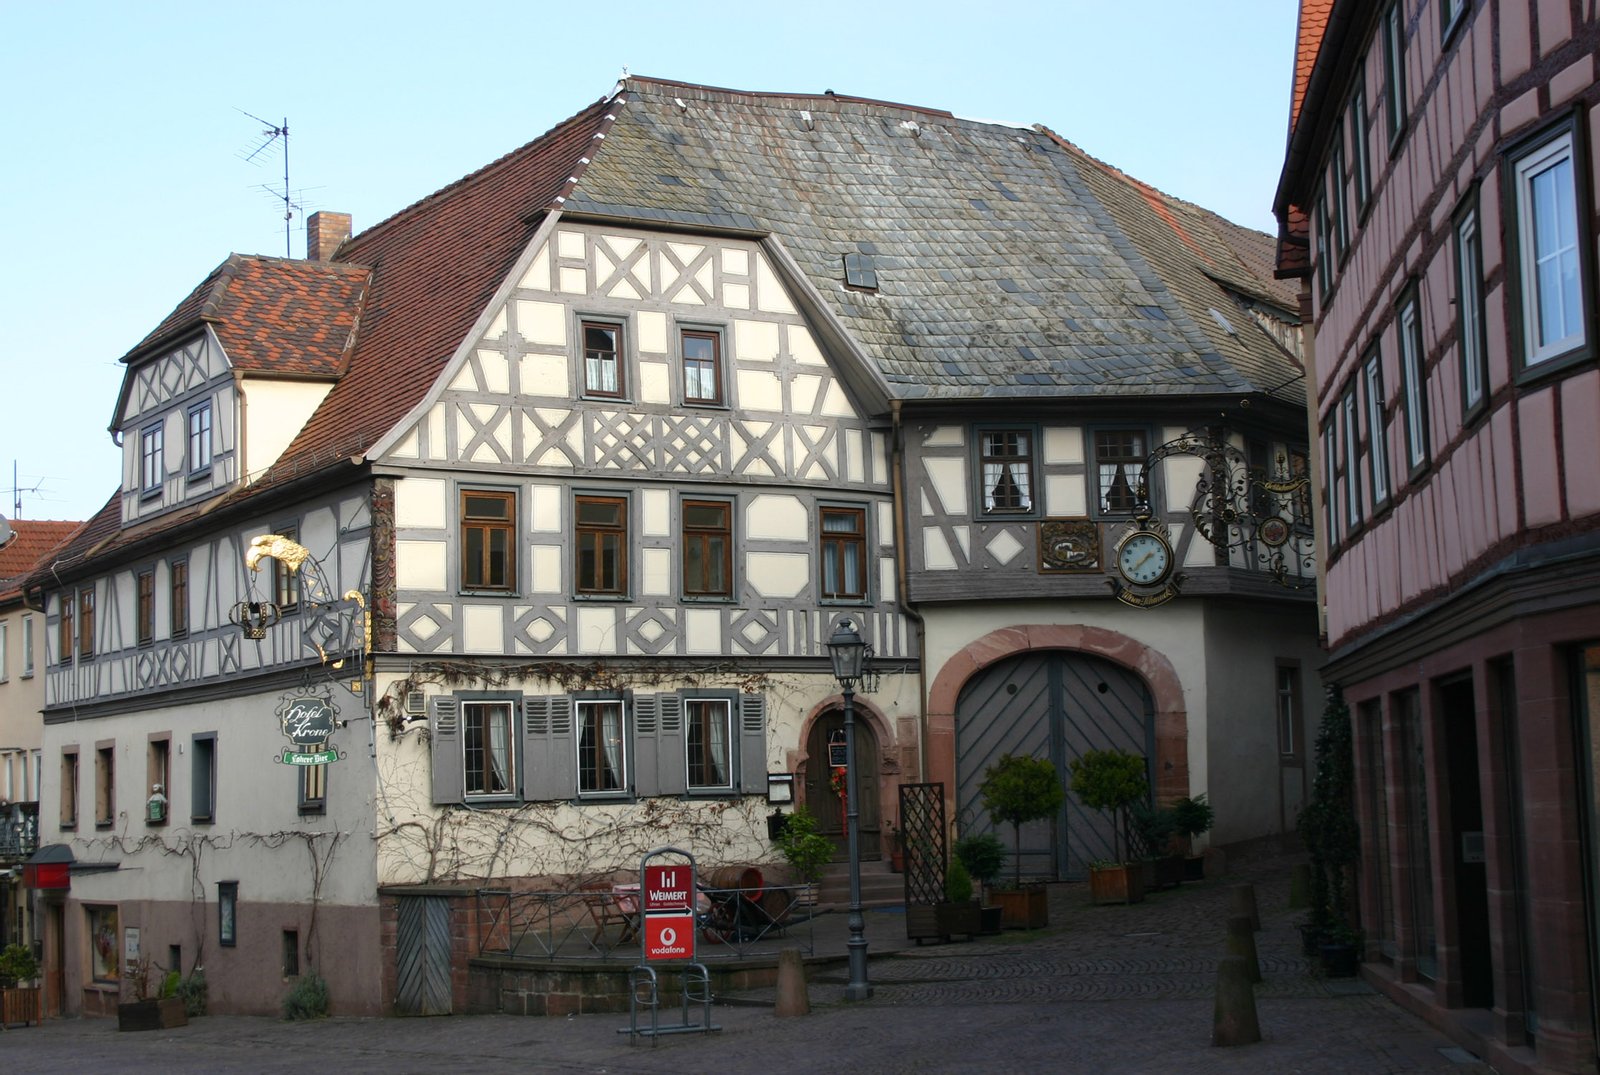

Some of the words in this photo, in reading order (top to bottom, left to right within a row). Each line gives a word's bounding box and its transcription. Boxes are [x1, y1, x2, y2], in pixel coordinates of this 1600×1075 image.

[287, 705, 323, 723] Hotel
[292, 719, 329, 737] Krone
[314, 754, 329, 763] Bier
[649, 890, 687, 901] WEIMERT
[651, 946, 686, 954] vodafone
